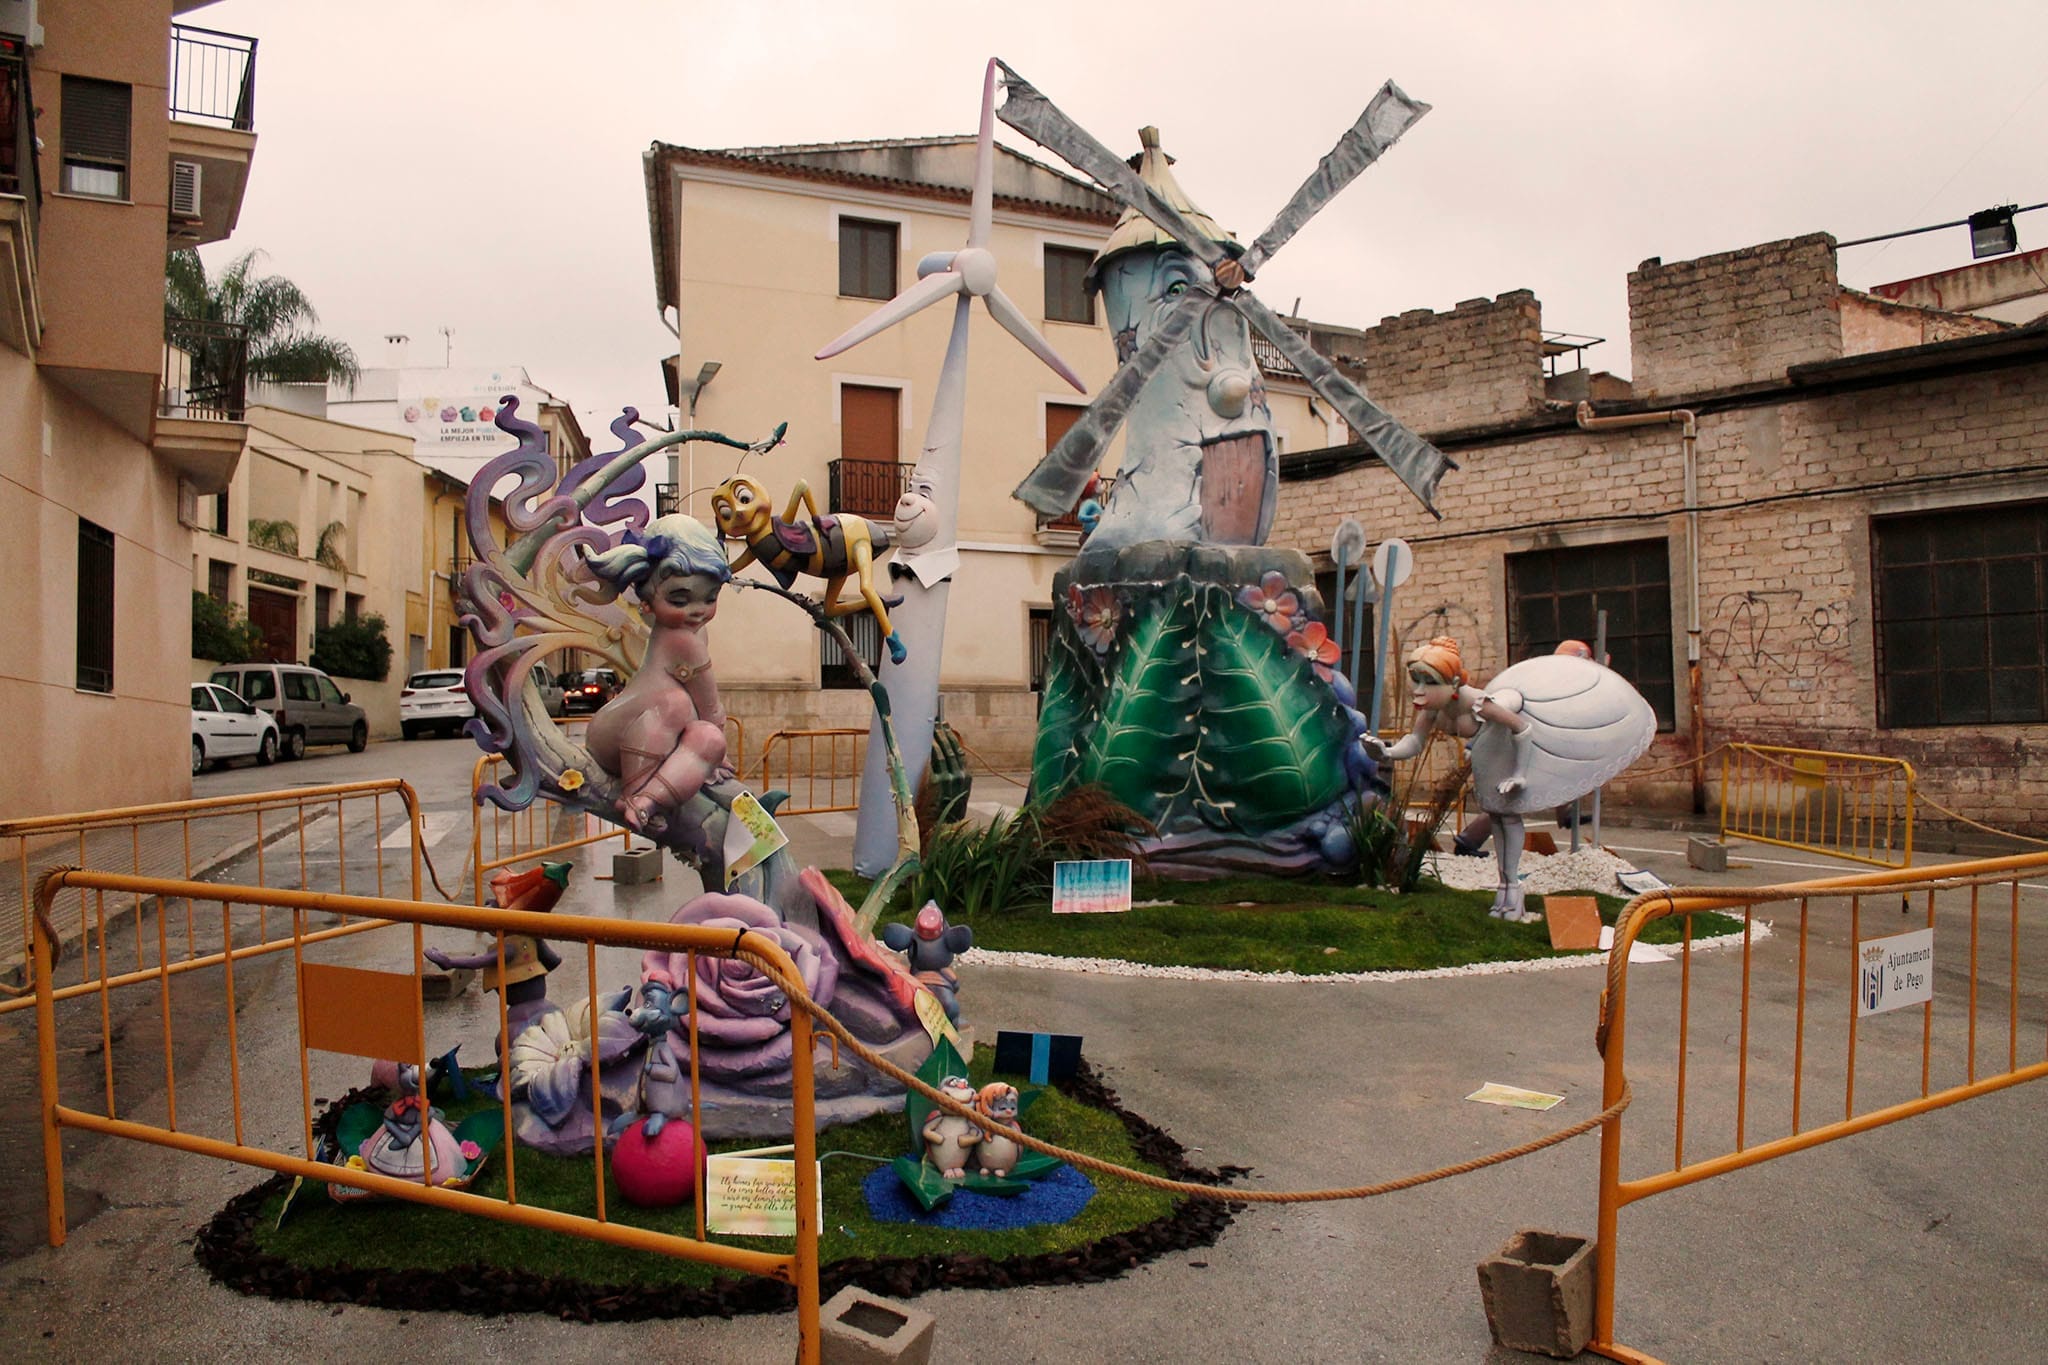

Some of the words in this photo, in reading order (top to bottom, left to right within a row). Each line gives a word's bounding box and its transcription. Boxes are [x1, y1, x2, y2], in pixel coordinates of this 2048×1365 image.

[440, 427, 449, 435] LA
[1887, 947, 1930, 972] Ajuntament
[1893, 975, 1903, 991] de
[1906, 972, 1924, 990] Pego
[755, 1185, 775, 1195] belles
